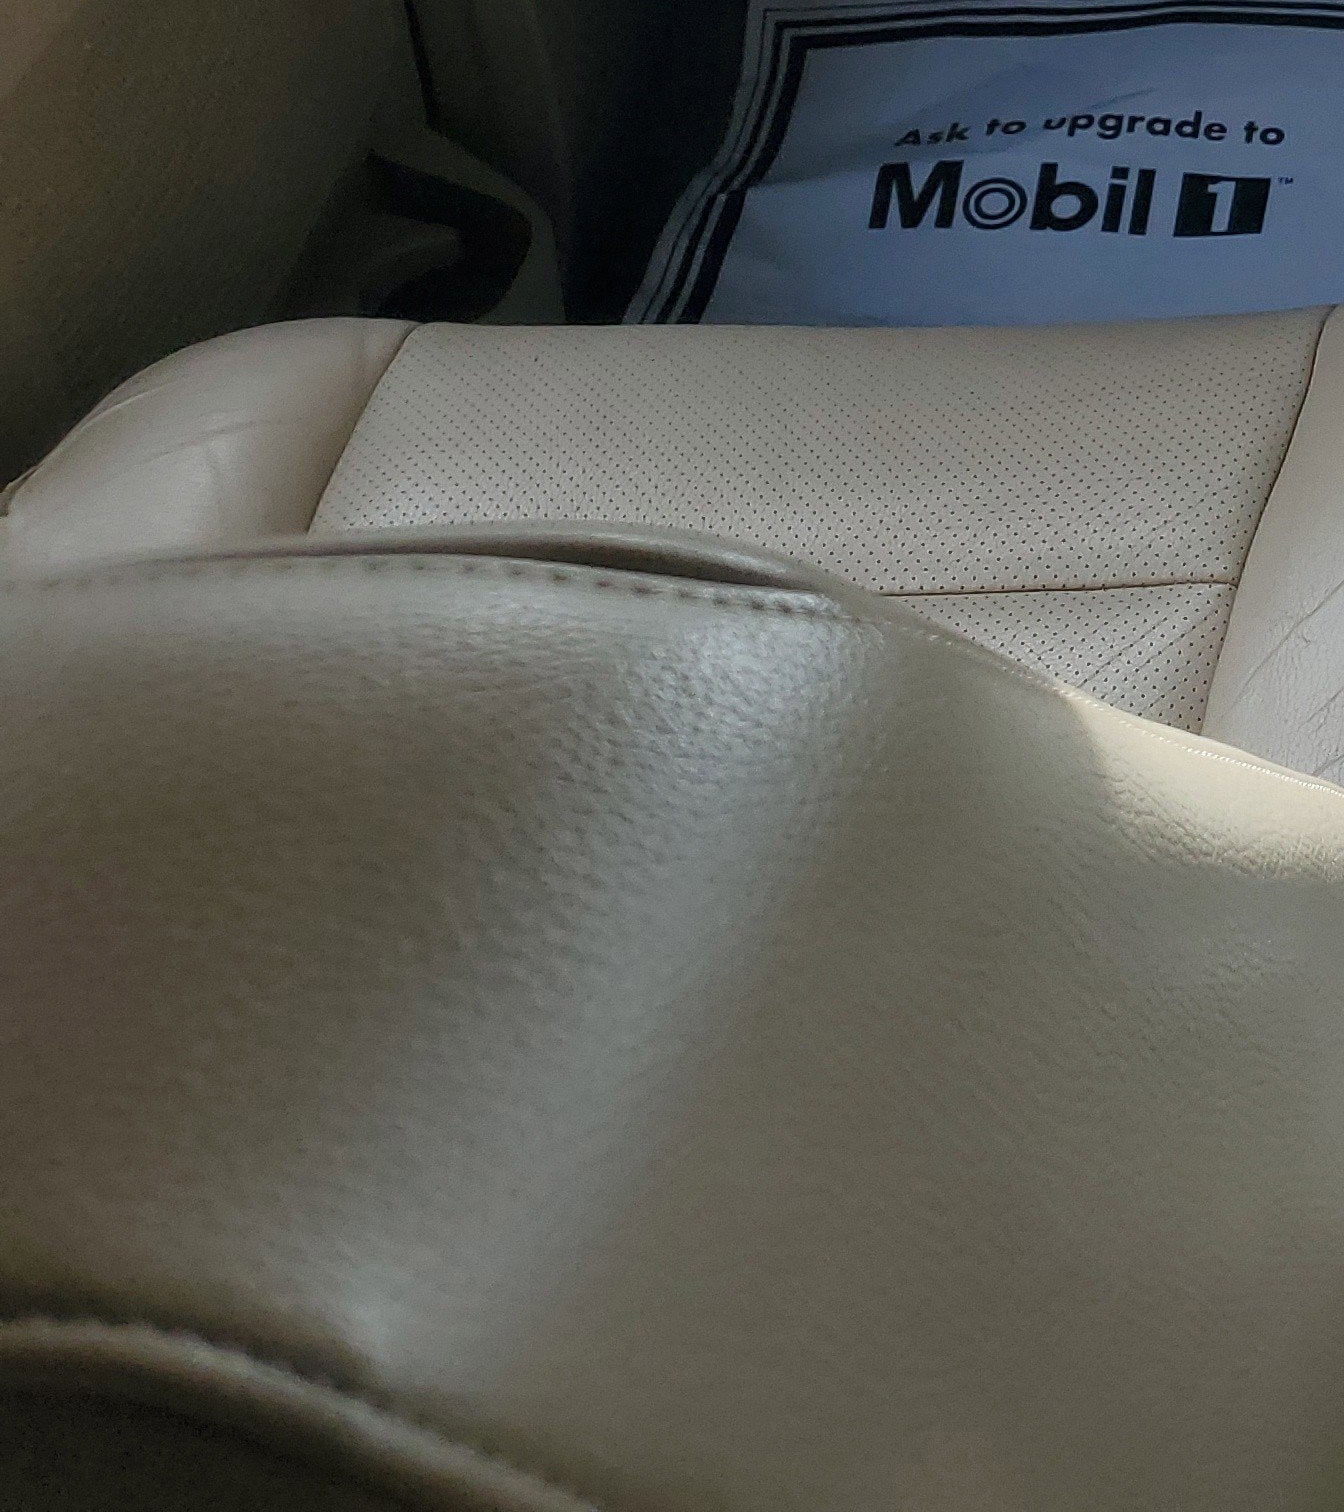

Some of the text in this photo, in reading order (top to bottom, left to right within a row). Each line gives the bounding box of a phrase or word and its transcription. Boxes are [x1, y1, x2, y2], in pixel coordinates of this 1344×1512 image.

[895, 110, 1286, 147] Ask to upgrade to
[868, 160, 1157, 236] Mobil
